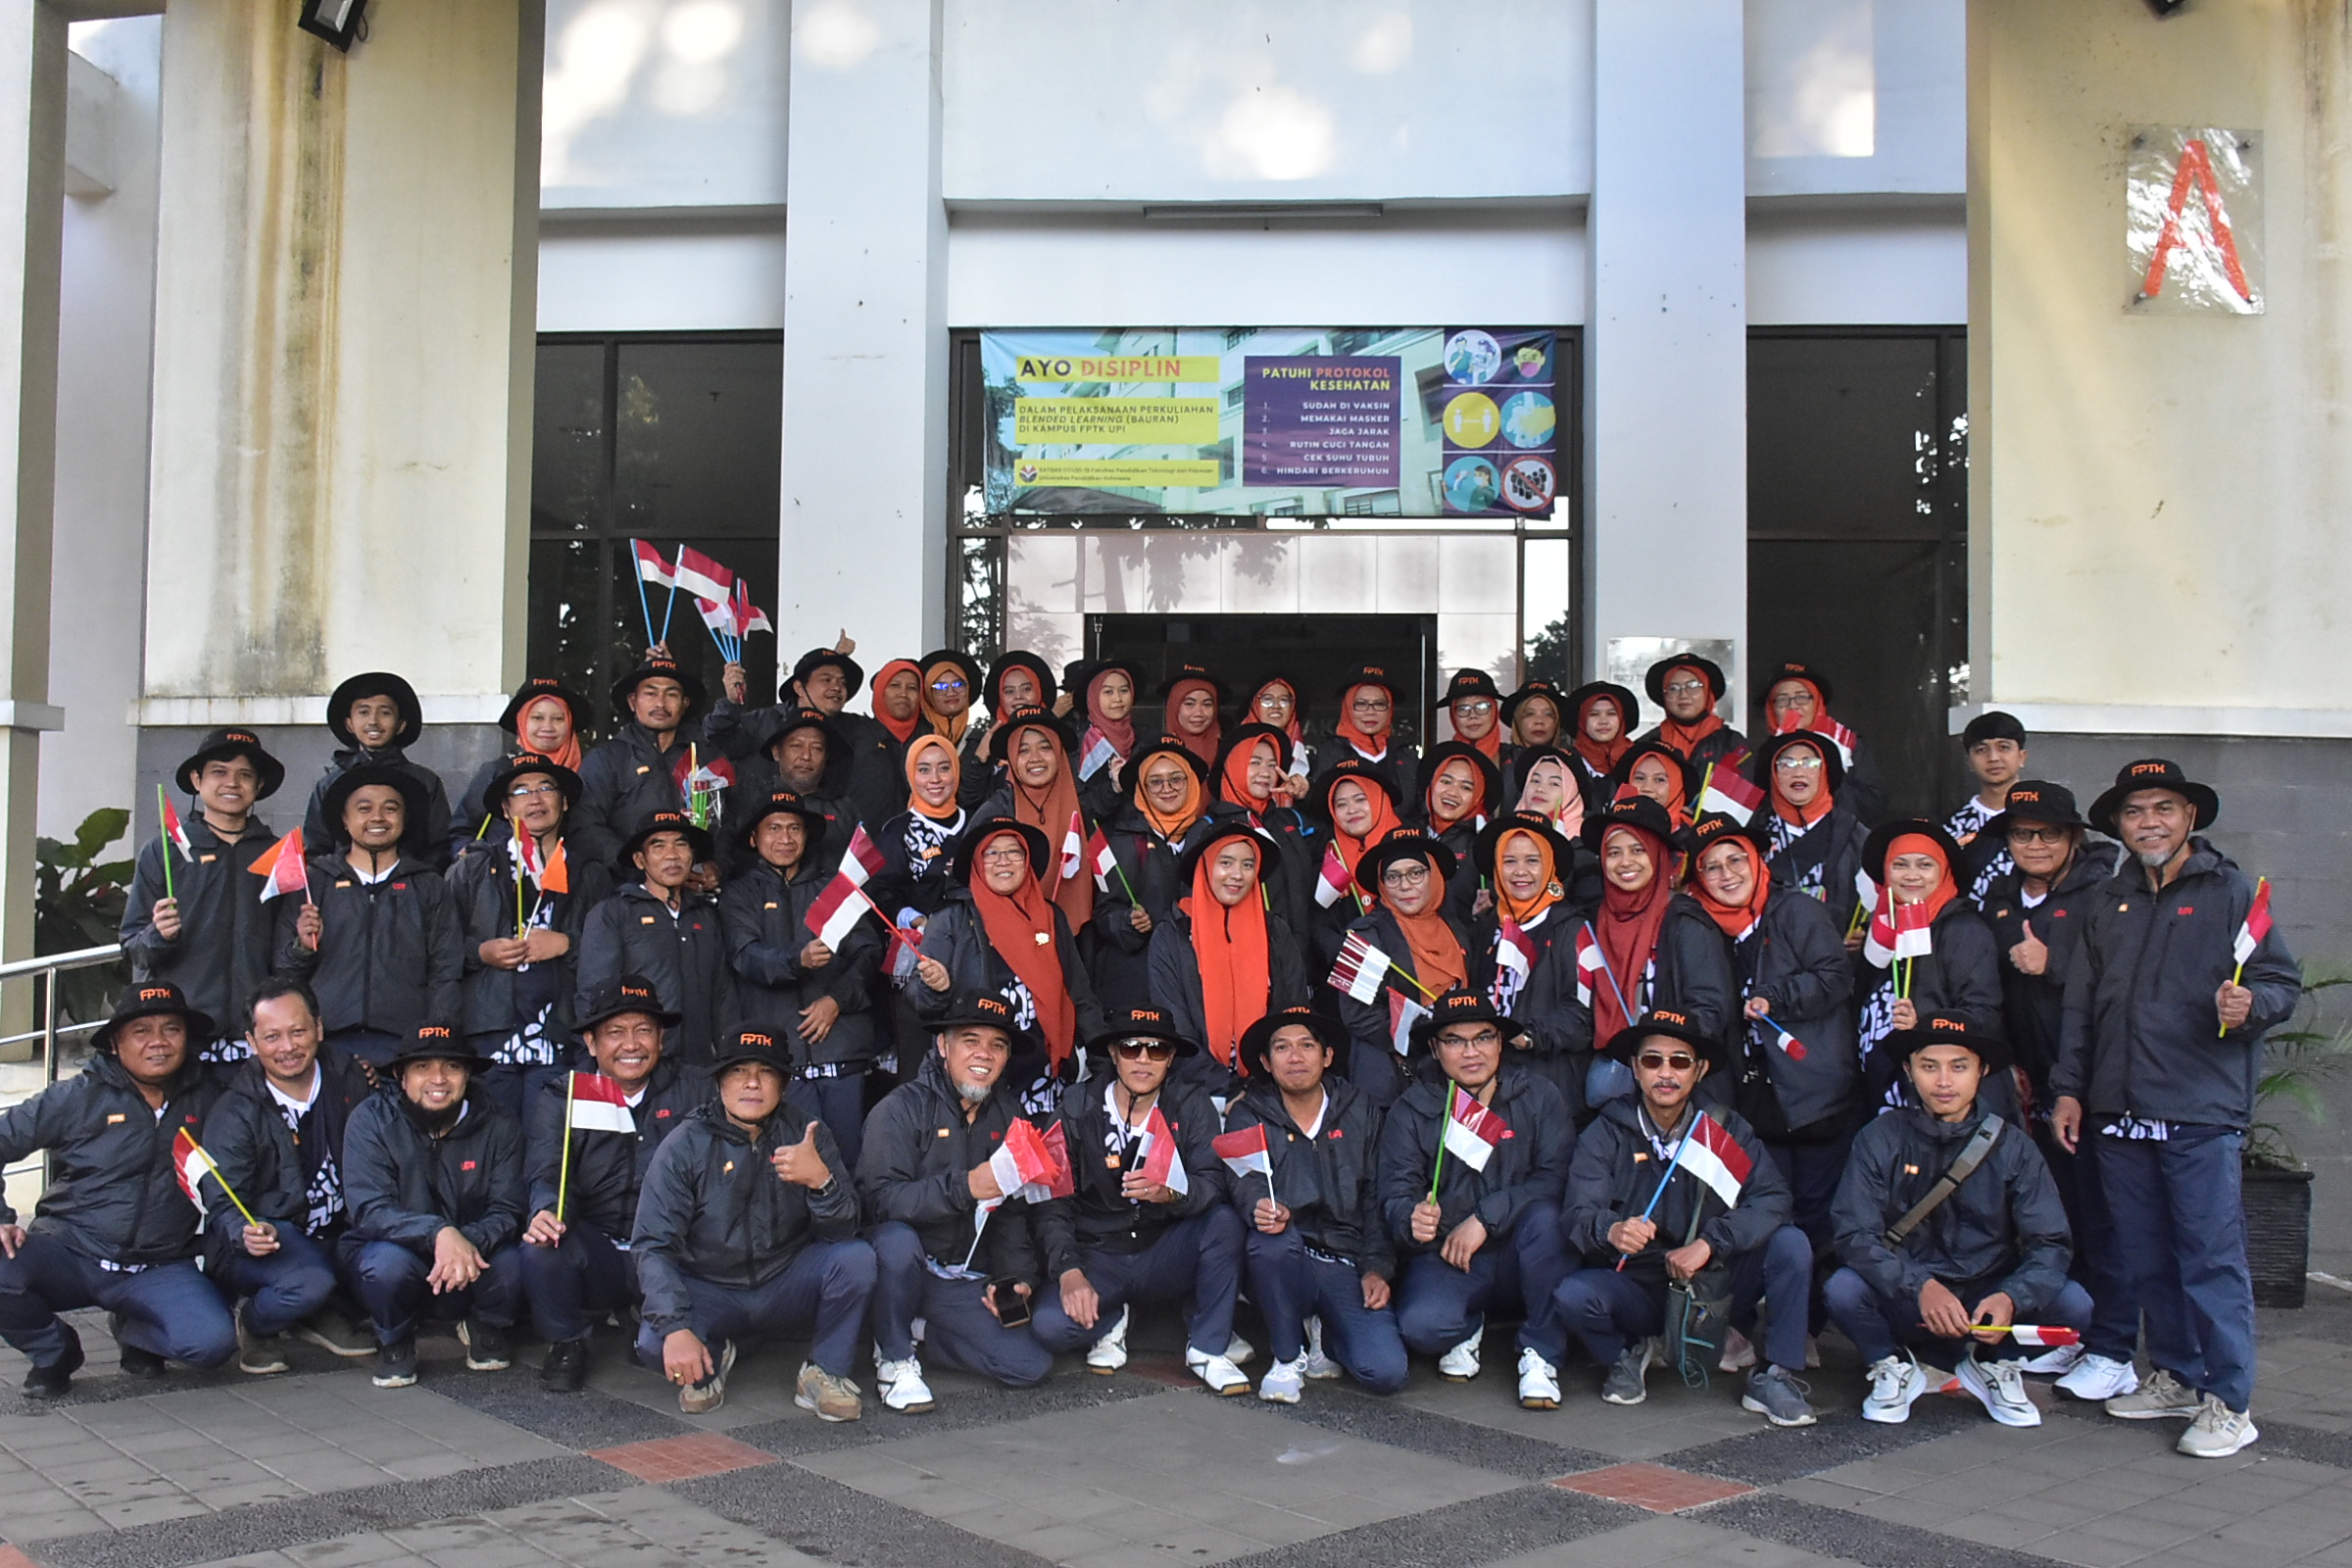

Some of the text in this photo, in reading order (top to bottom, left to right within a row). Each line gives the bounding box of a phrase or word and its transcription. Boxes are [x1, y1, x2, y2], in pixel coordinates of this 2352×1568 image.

[2143, 139, 2250, 301] A
[1020, 359, 1181, 377] AYO DISIPLIN
[1262, 368, 1391, 378] PATUHI PROTOKOL
[1310, 380, 1391, 391] KESEHATAN
[1019, 406, 1214, 415] DALAM PELAKSANAAN PERKULIAHAN
[1070, 416, 1123, 424] LEARNING
[1126, 416, 1179, 424] (BAURAN)
[1458, 676, 1481, 686] FPTK
[513, 755, 540, 767] FPTK
[2132, 762, 2167, 776] FPTK
[771, 792, 797, 802] FPTK
[2010, 790, 2039, 803] FPTK
[655, 812, 681, 822] FPTK
[1695, 818, 1724, 837] FPTK
[1393, 828, 1420, 840] FPTK
[140, 987, 172, 1001] FPTK
[977, 998, 1007, 1015] FPTK
[1448, 995, 1479, 1007] FPTK
[1131, 1009, 1160, 1021] FPTK
[1653, 1010, 1688, 1025] FPTK
[1932, 1018, 1966, 1032] FPTK
[418, 1026, 451, 1039] FPTK
[740, 1032, 773, 1047] FPTK
